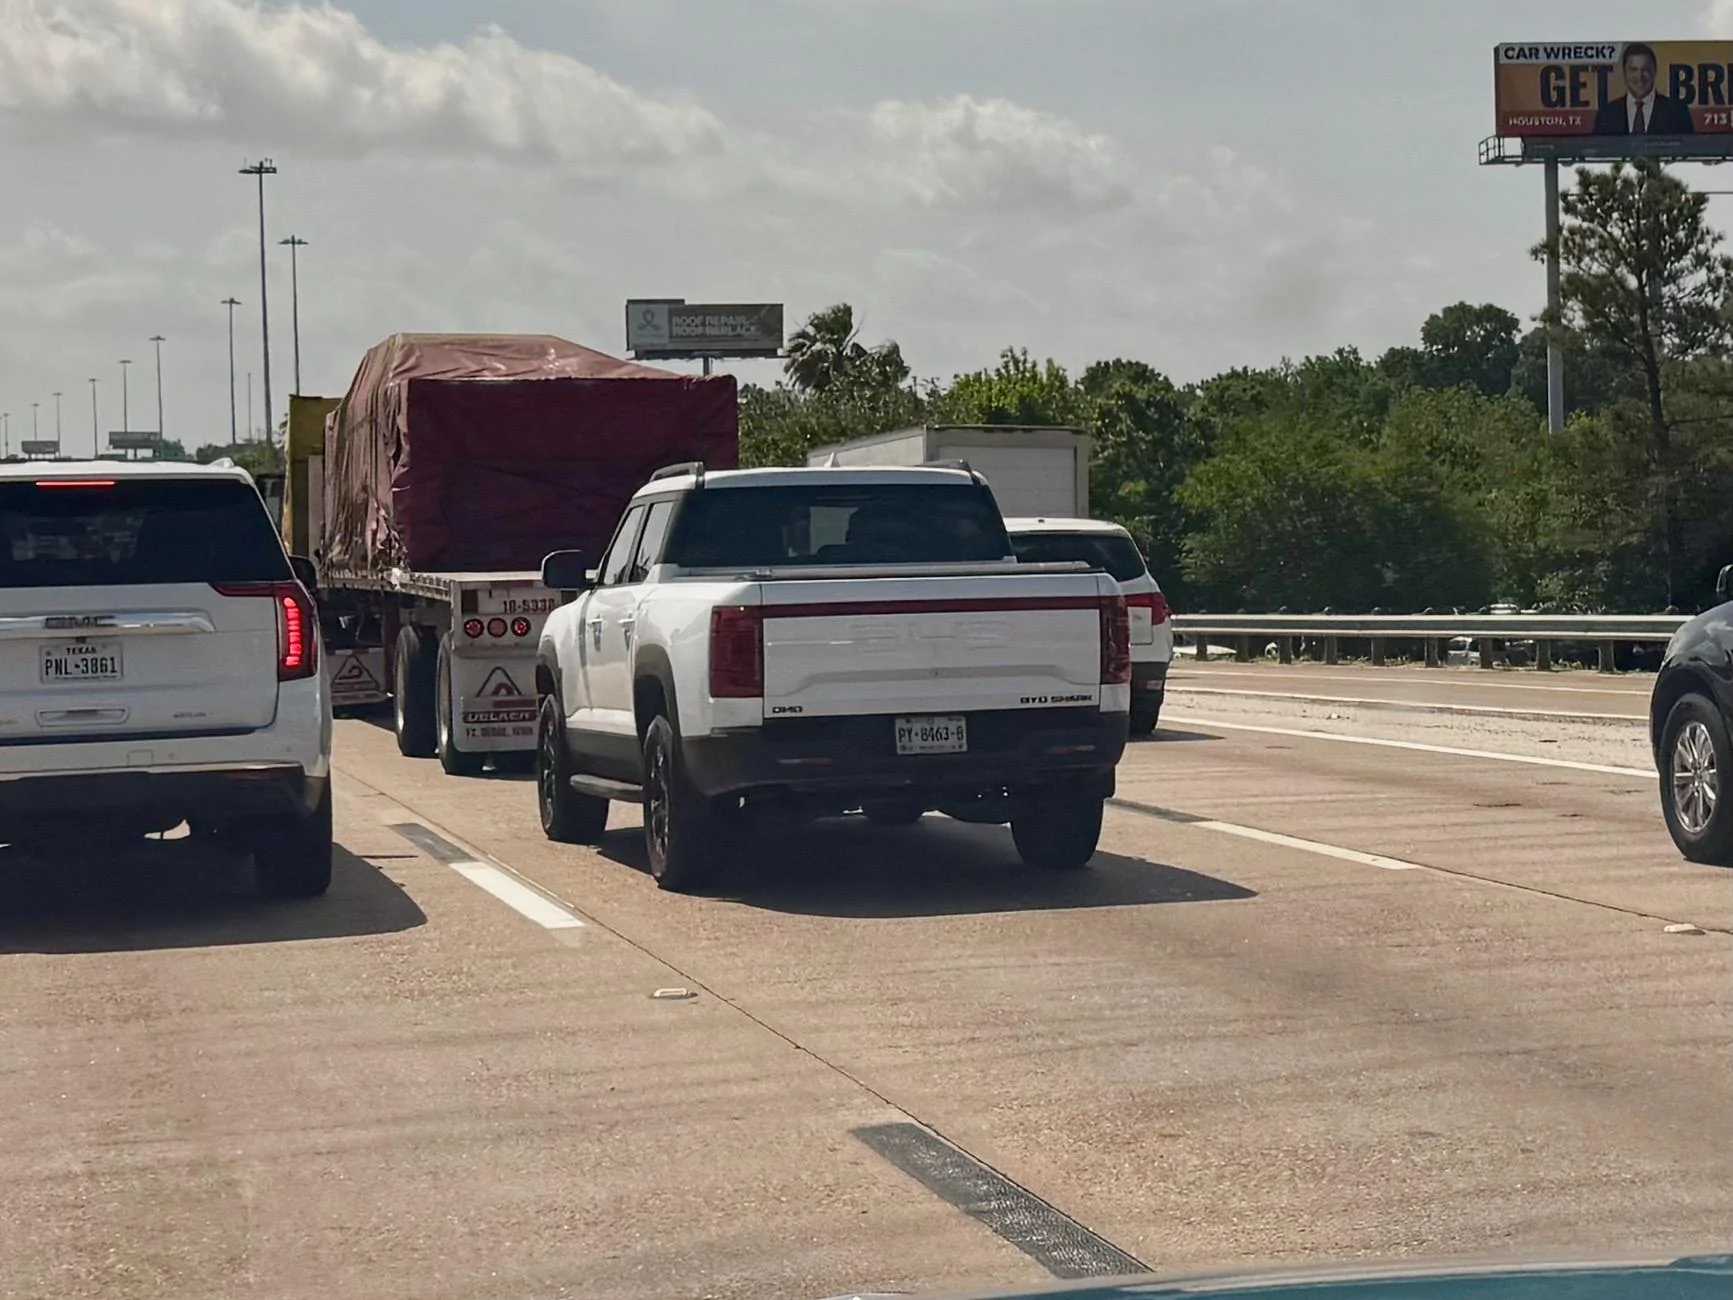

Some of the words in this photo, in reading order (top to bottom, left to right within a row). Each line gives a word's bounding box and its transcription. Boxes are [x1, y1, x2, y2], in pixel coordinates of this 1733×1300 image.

[1504, 46, 1540, 60] CAR
[1545, 46, 1616, 60] WRECK?
[1540, 64, 1614, 109] GET
[1568, 115, 1582, 126] TX
[66, 646, 97, 656] TEXAS
